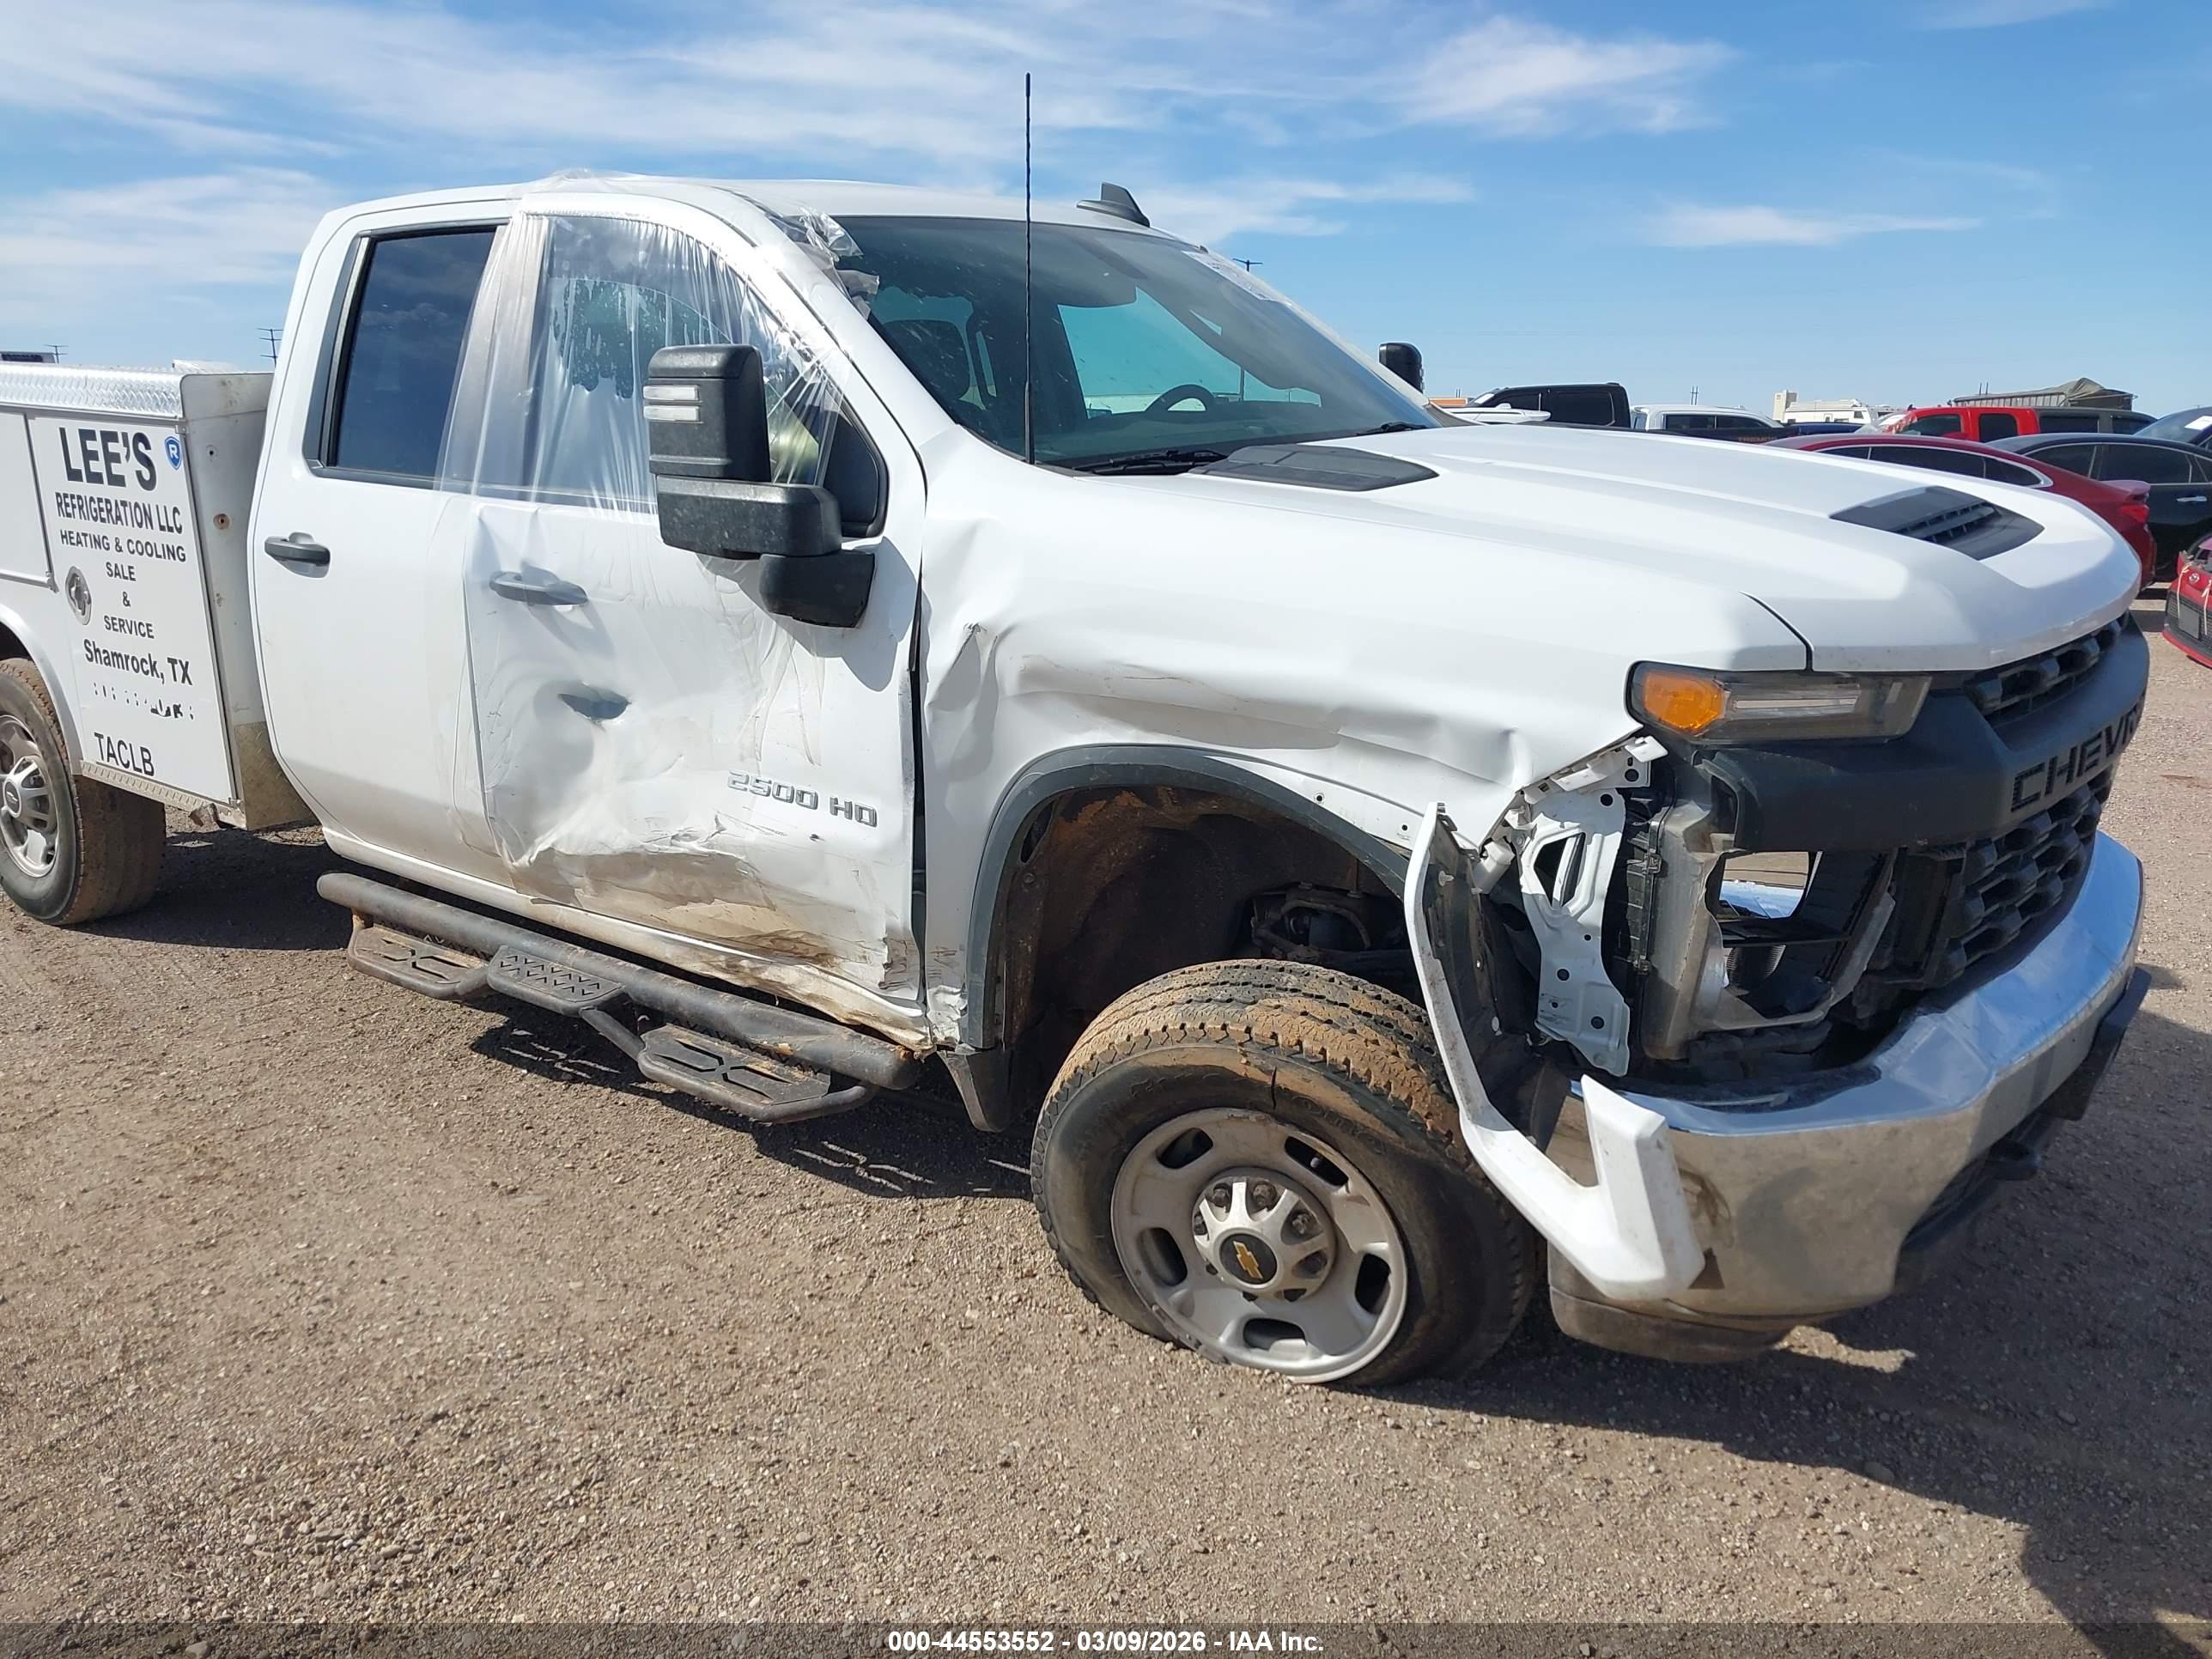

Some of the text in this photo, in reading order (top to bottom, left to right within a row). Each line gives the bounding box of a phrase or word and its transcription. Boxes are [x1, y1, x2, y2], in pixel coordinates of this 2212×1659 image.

[59, 427, 157, 491] LEE'S
[55, 492, 183, 534] REFRIGERATION LLC
[60, 529, 186, 562] HEATING & COOLING
[106, 561, 137, 581] SALE
[122, 591, 131, 607] &
[104, 615, 155, 639] SERVICE
[83, 638, 193, 686] Shamrock, TX
[94, 732, 155, 777] TACLB
[727, 769, 878, 829] 2500 HD
